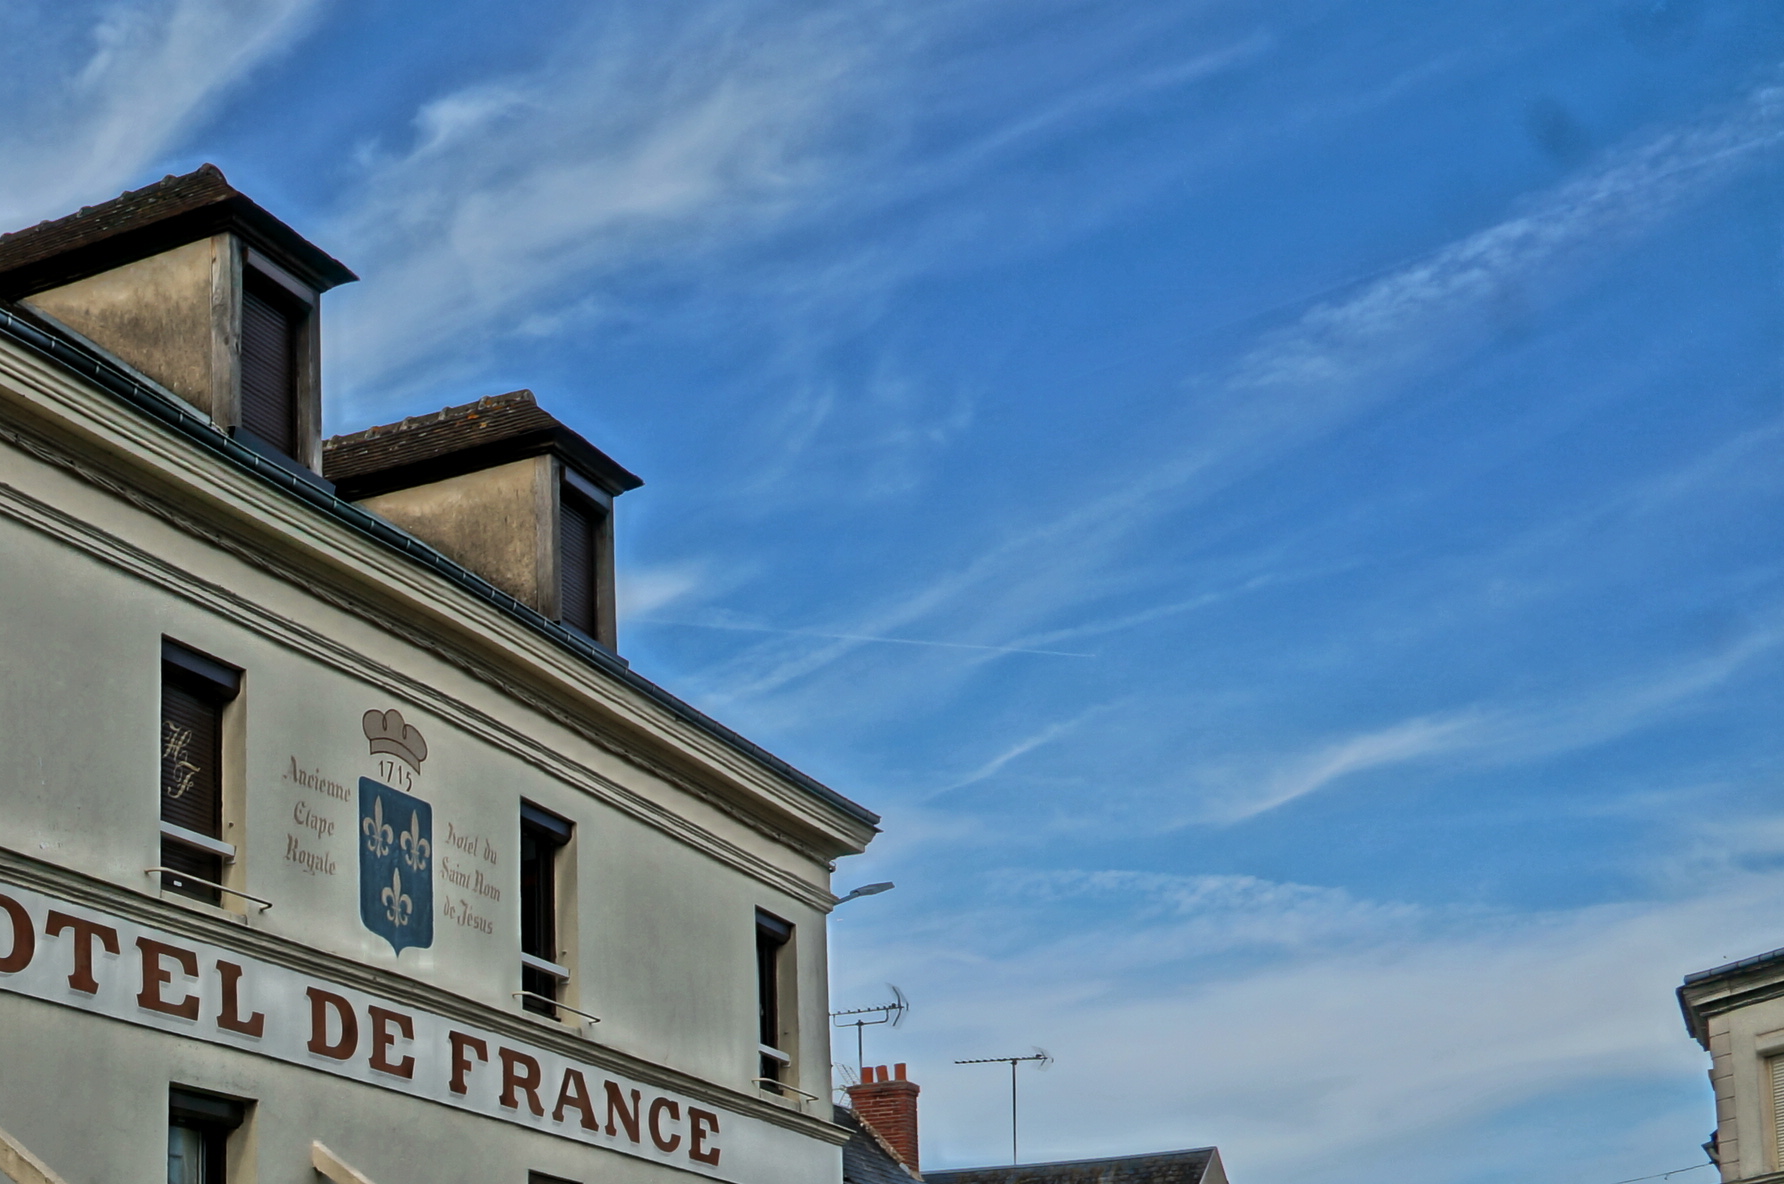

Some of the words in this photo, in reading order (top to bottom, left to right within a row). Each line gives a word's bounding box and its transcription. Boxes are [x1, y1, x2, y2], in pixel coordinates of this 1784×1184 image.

[283, 755, 351, 802] Ancienne
[378, 760, 412, 792] 1715
[283, 833, 336, 876] Royale
[483, 838, 497, 865] du
[440, 856, 471, 889] Saint
[472, 870, 501, 902] Nom
[443, 895, 456, 919] de
[305, 986, 416, 1080] DE
[448, 1030, 721, 1166] FRANCE
